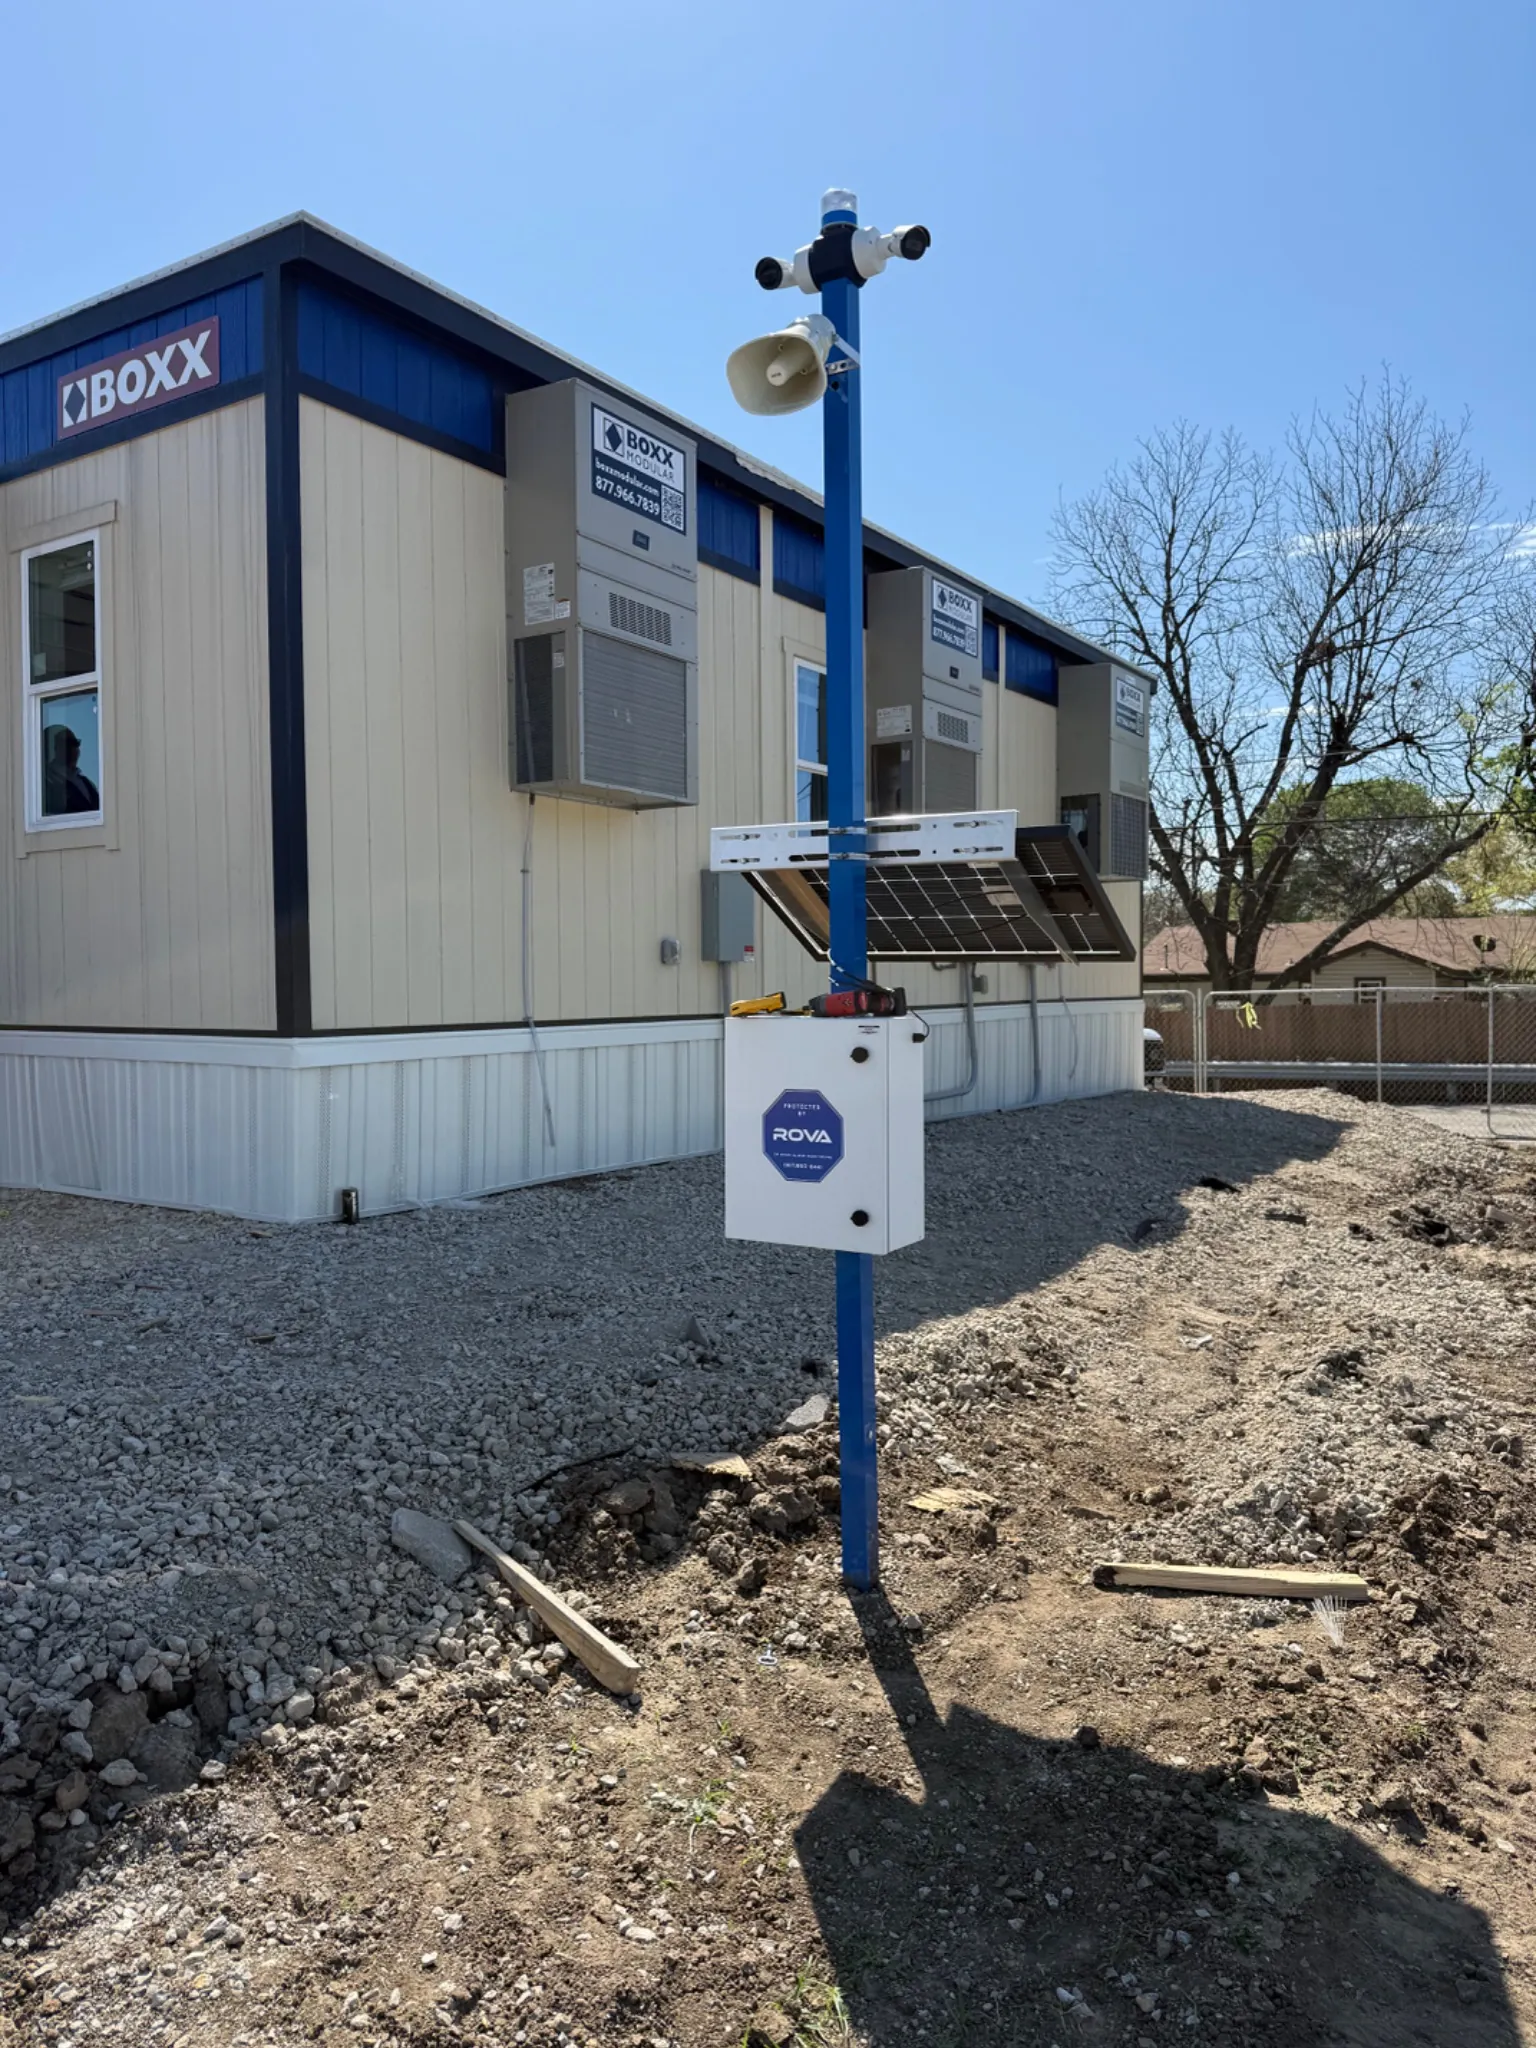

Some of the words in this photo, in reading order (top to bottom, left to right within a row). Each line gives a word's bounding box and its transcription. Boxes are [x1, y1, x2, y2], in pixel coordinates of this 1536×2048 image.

[91, 329, 212, 418] BOXX
[626, 428, 674, 469] BOXX
[626, 450, 674, 482] MODULAR
[594, 456, 660, 497] boxxmodular.com
[595, 475, 660, 516] 877.966.7839
[948, 590, 972, 613] BOXX
[773, 1127, 832, 1143] ROVA
